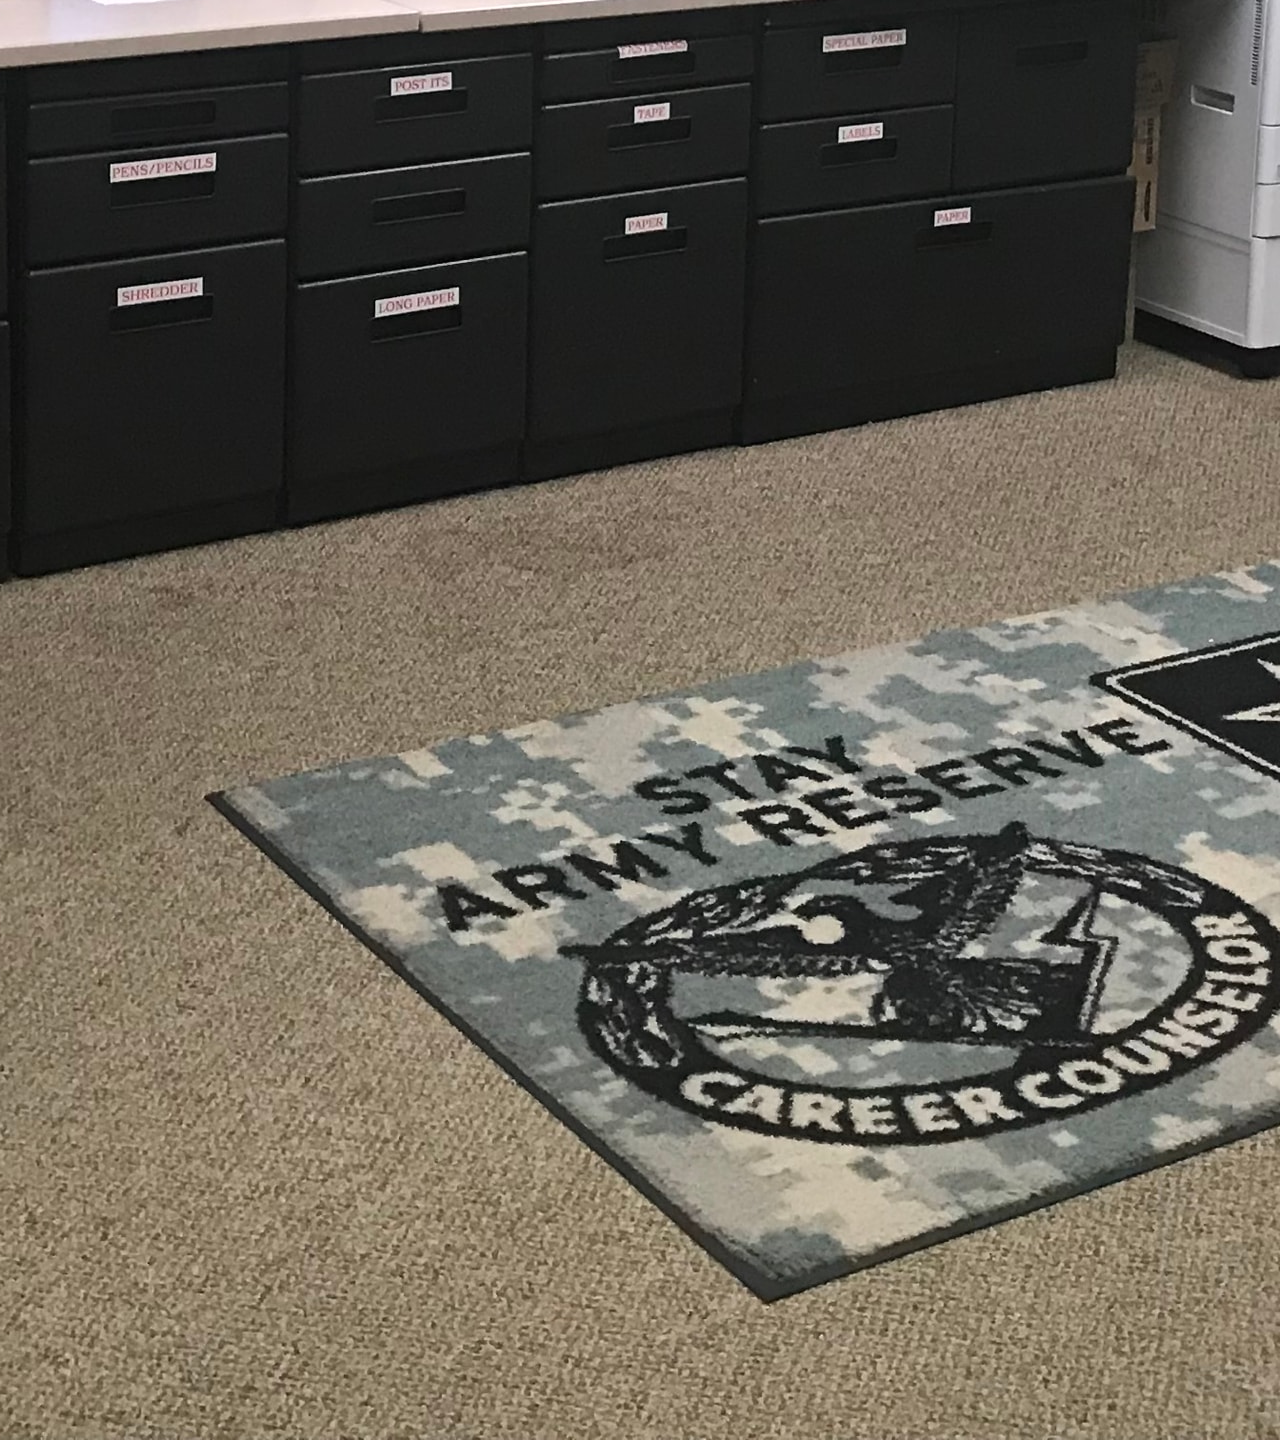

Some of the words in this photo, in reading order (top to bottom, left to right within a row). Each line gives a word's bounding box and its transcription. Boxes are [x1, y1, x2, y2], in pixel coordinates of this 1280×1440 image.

[824, 32, 868, 50] SPECIAL
[871, 28, 904, 44] PAPER
[395, 78, 427, 93] POST
[430, 74, 450, 89] ITS
[637, 106, 666, 121] TAPE
[841, 125, 882, 140] LABELS
[112, 156, 215, 179] PENS/PENCILS
[628, 217, 665, 232] PAPER
[935, 212, 969, 225] PAPER
[122, 281, 199, 303] SHREDDER
[378, 296, 414, 315] LONG
[417, 291, 457, 308] PAPER
[634, 735, 861, 816] STAY
[436, 822, 718, 933] ARMY
[736, 717, 1174, 847] RESERVE
[677, 1070, 1021, 1137] CAREER
[1014, 911, 1272, 1110] COUNSELOR
